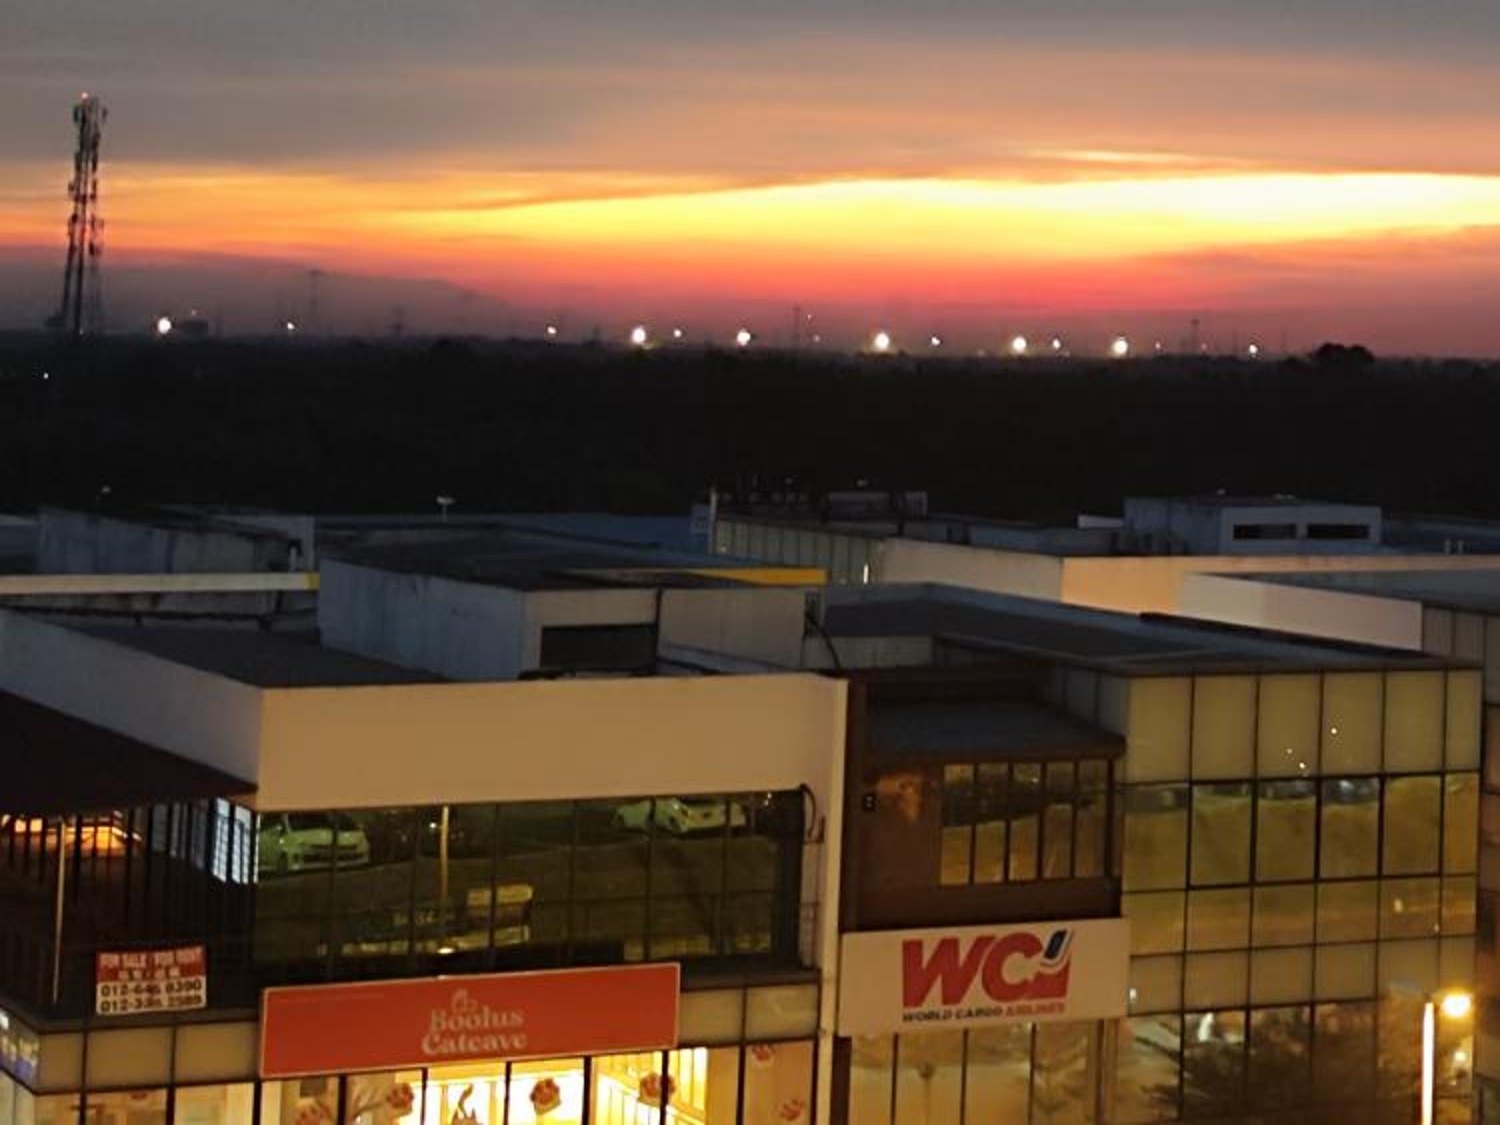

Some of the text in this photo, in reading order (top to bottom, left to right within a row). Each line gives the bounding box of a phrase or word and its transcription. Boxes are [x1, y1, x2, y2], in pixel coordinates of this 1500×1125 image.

[430, 1005, 524, 1032] Boolus
[902, 1007, 952, 1022] WORLD
[954, 1006, 1003, 1020] CARGO
[421, 1033, 528, 1055] Catcave
